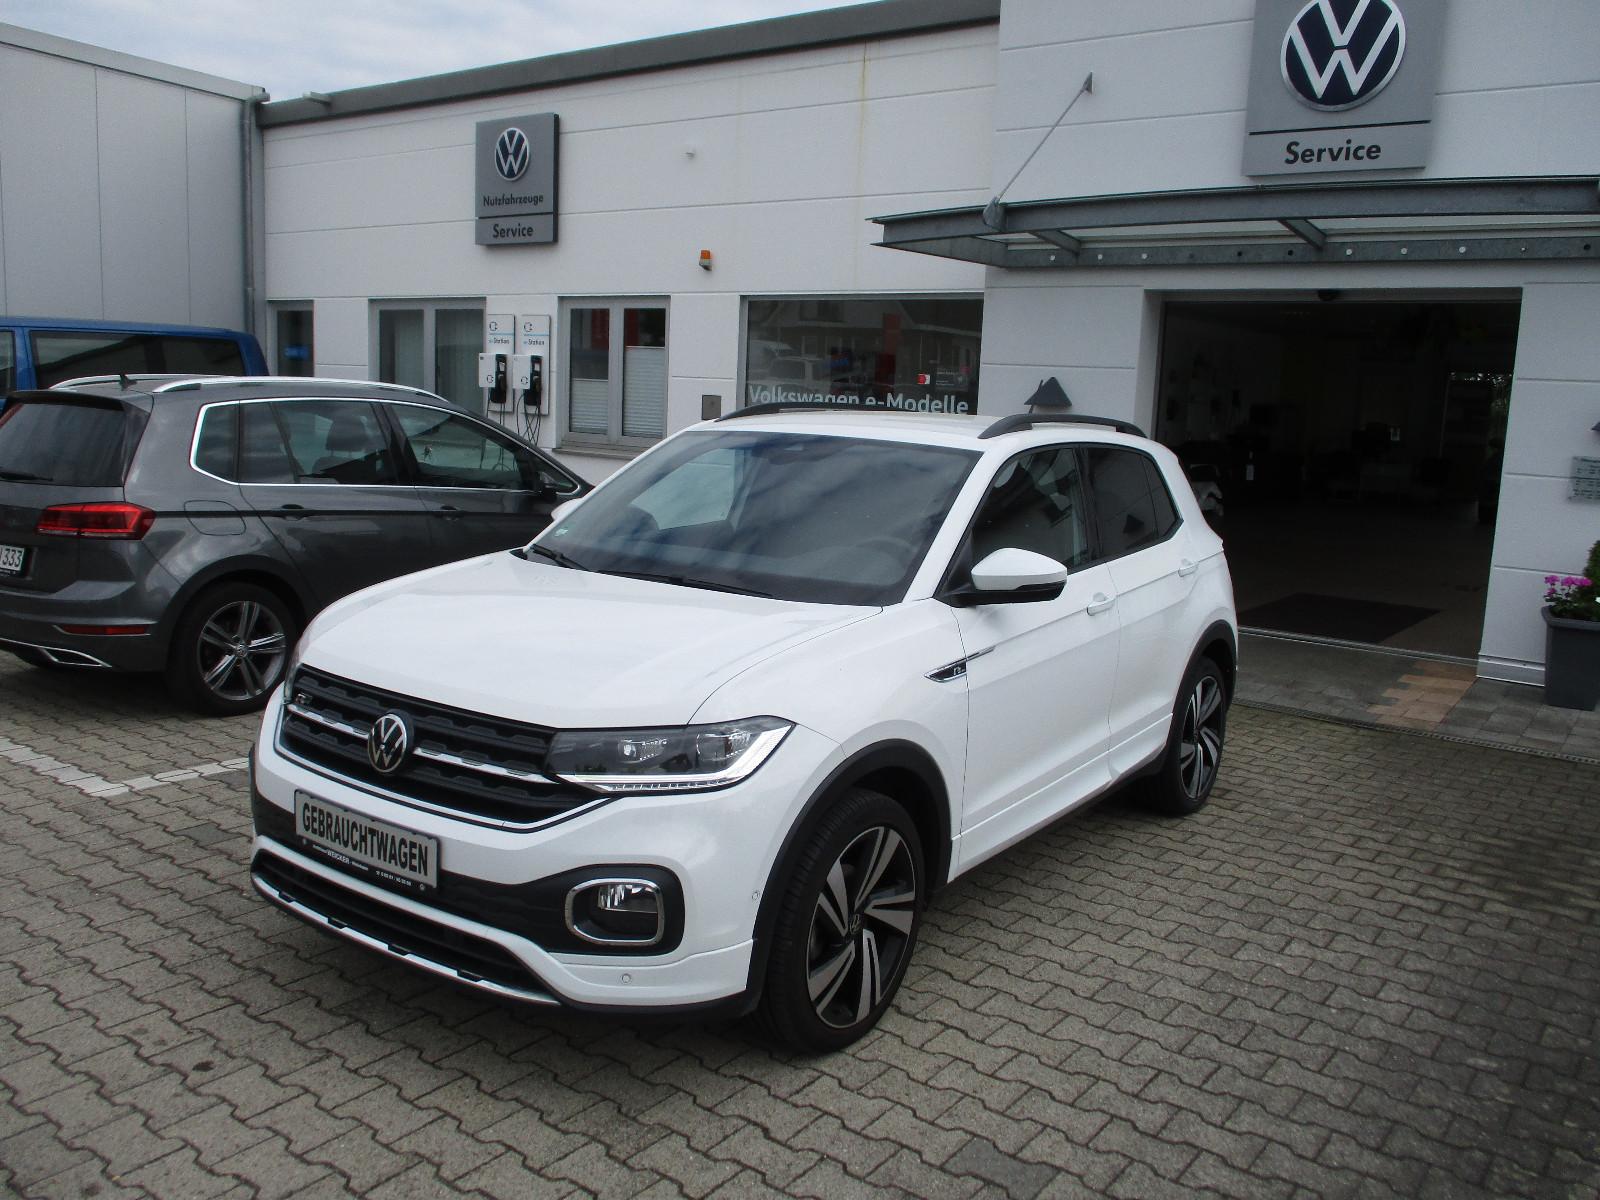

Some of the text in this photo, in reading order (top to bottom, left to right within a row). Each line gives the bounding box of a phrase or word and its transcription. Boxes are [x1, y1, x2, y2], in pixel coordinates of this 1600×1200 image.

[1284, 139, 1382, 165] Service
[483, 193, 544, 208] Nutzfahrzeuge
[492, 223, 534, 239] Service
[865, 392, 969, 414] e-Modelle
[0, 547, 23, 568] 333
[302, 802, 428, 877] GEBRAUCHTWAGEN
